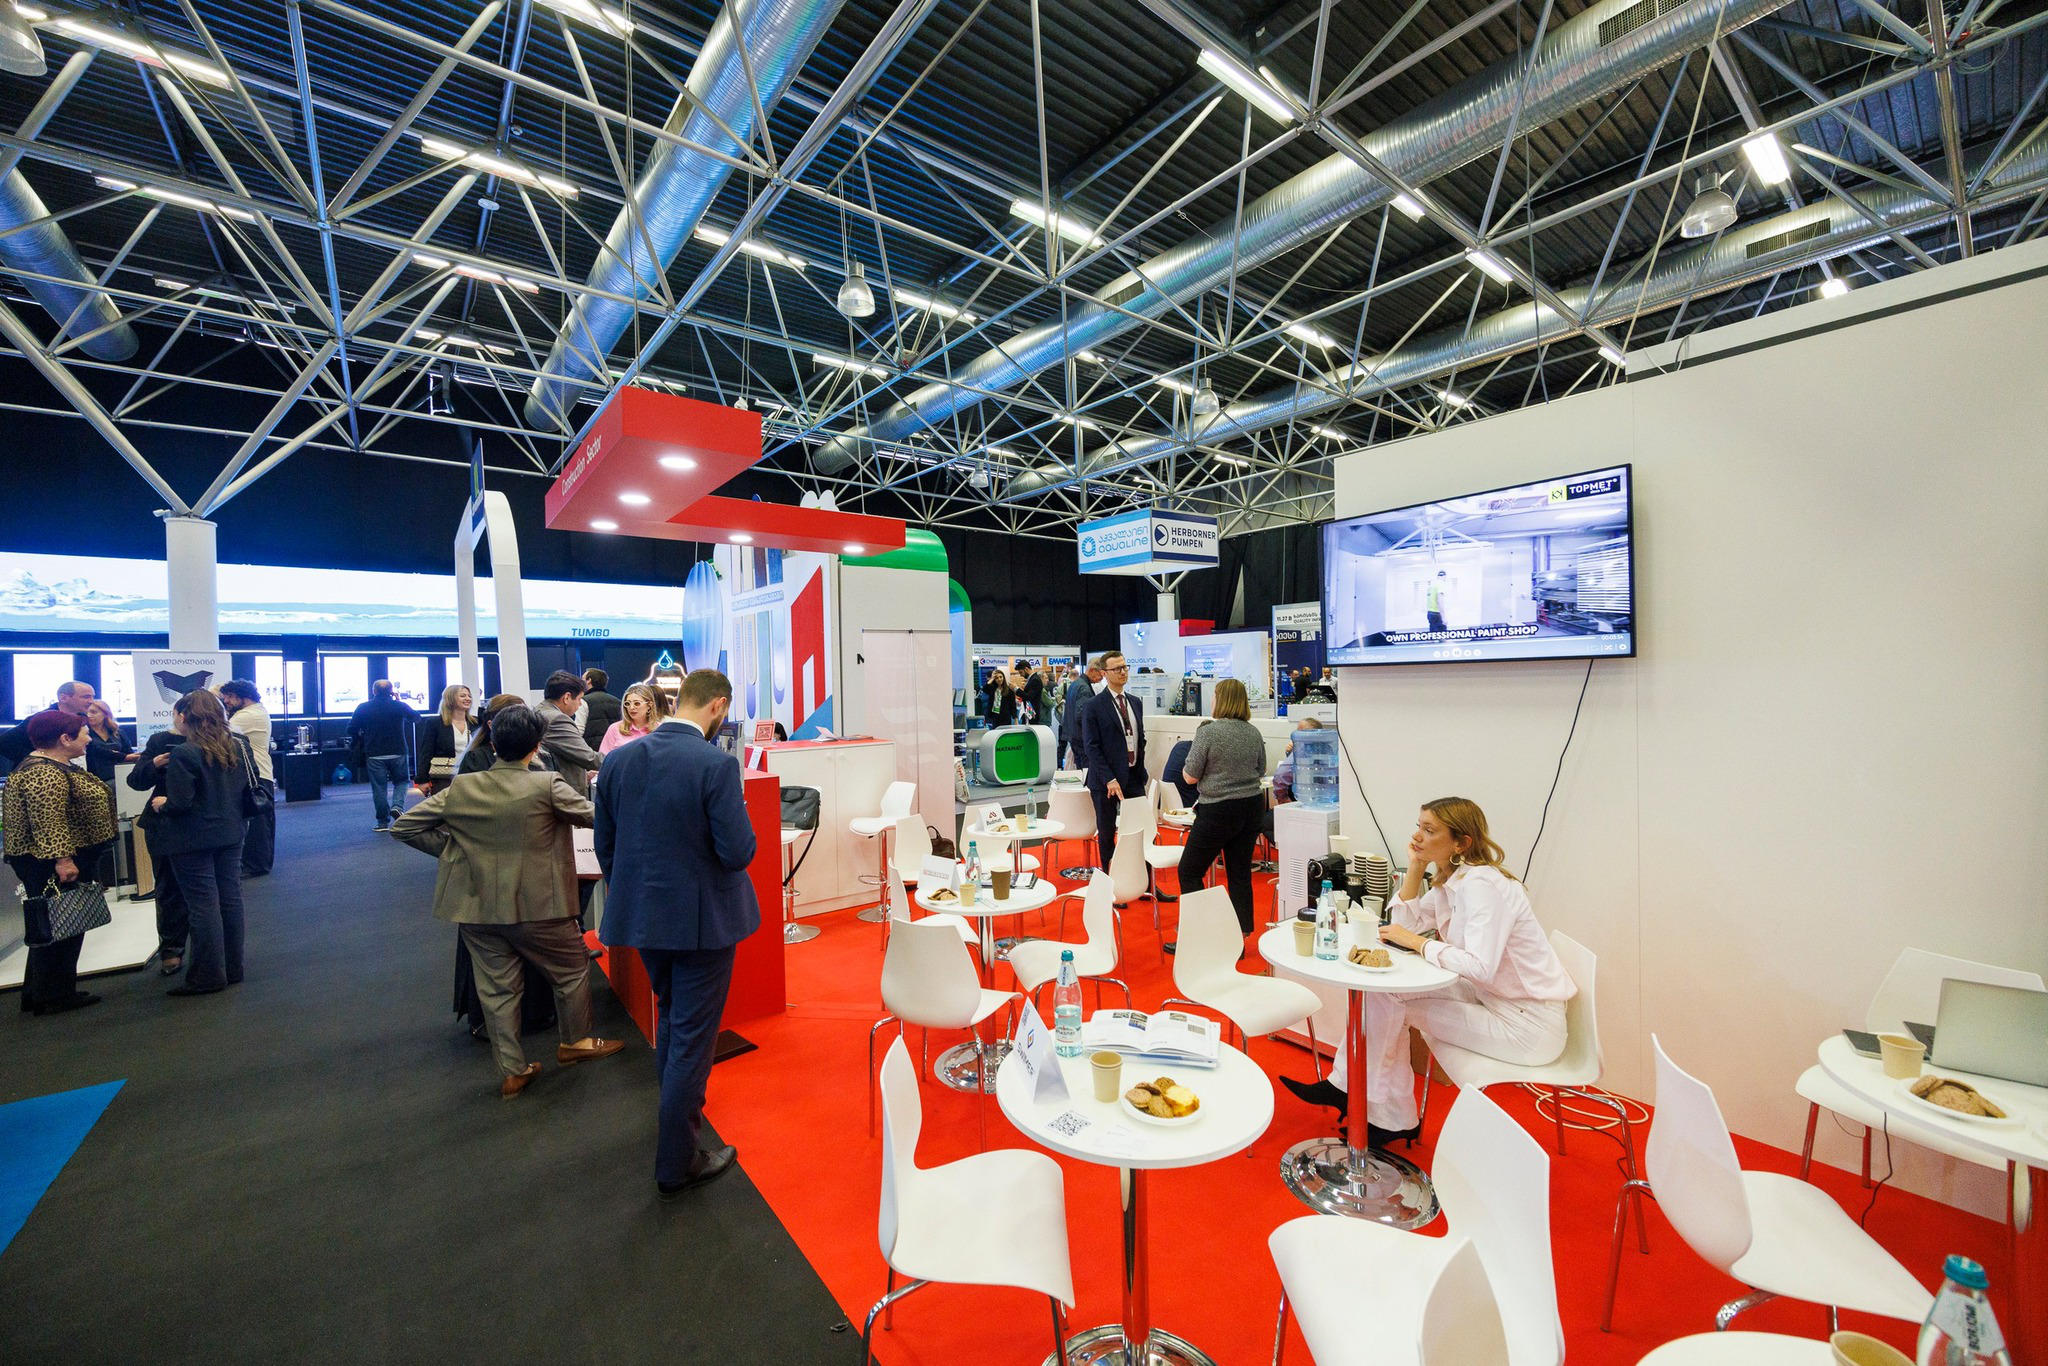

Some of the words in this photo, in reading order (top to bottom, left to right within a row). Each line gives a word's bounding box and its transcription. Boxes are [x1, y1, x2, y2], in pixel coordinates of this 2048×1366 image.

[562, 457, 585, 496] Construction
[586, 435, 601, 464] Sector
[1569, 480, 1612, 494] TOPMET
[1171, 527, 1216, 540] HERBORNER
[1171, 538, 1203, 548] PUMPEN
[572, 628, 610, 637] TUMBO
[1386, 633, 1408, 643] OWN
[1409, 628, 1476, 641] PROFESSIONAL
[1477, 626, 1507, 637] PAINT
[1508, 625, 1538, 636] SHOP
